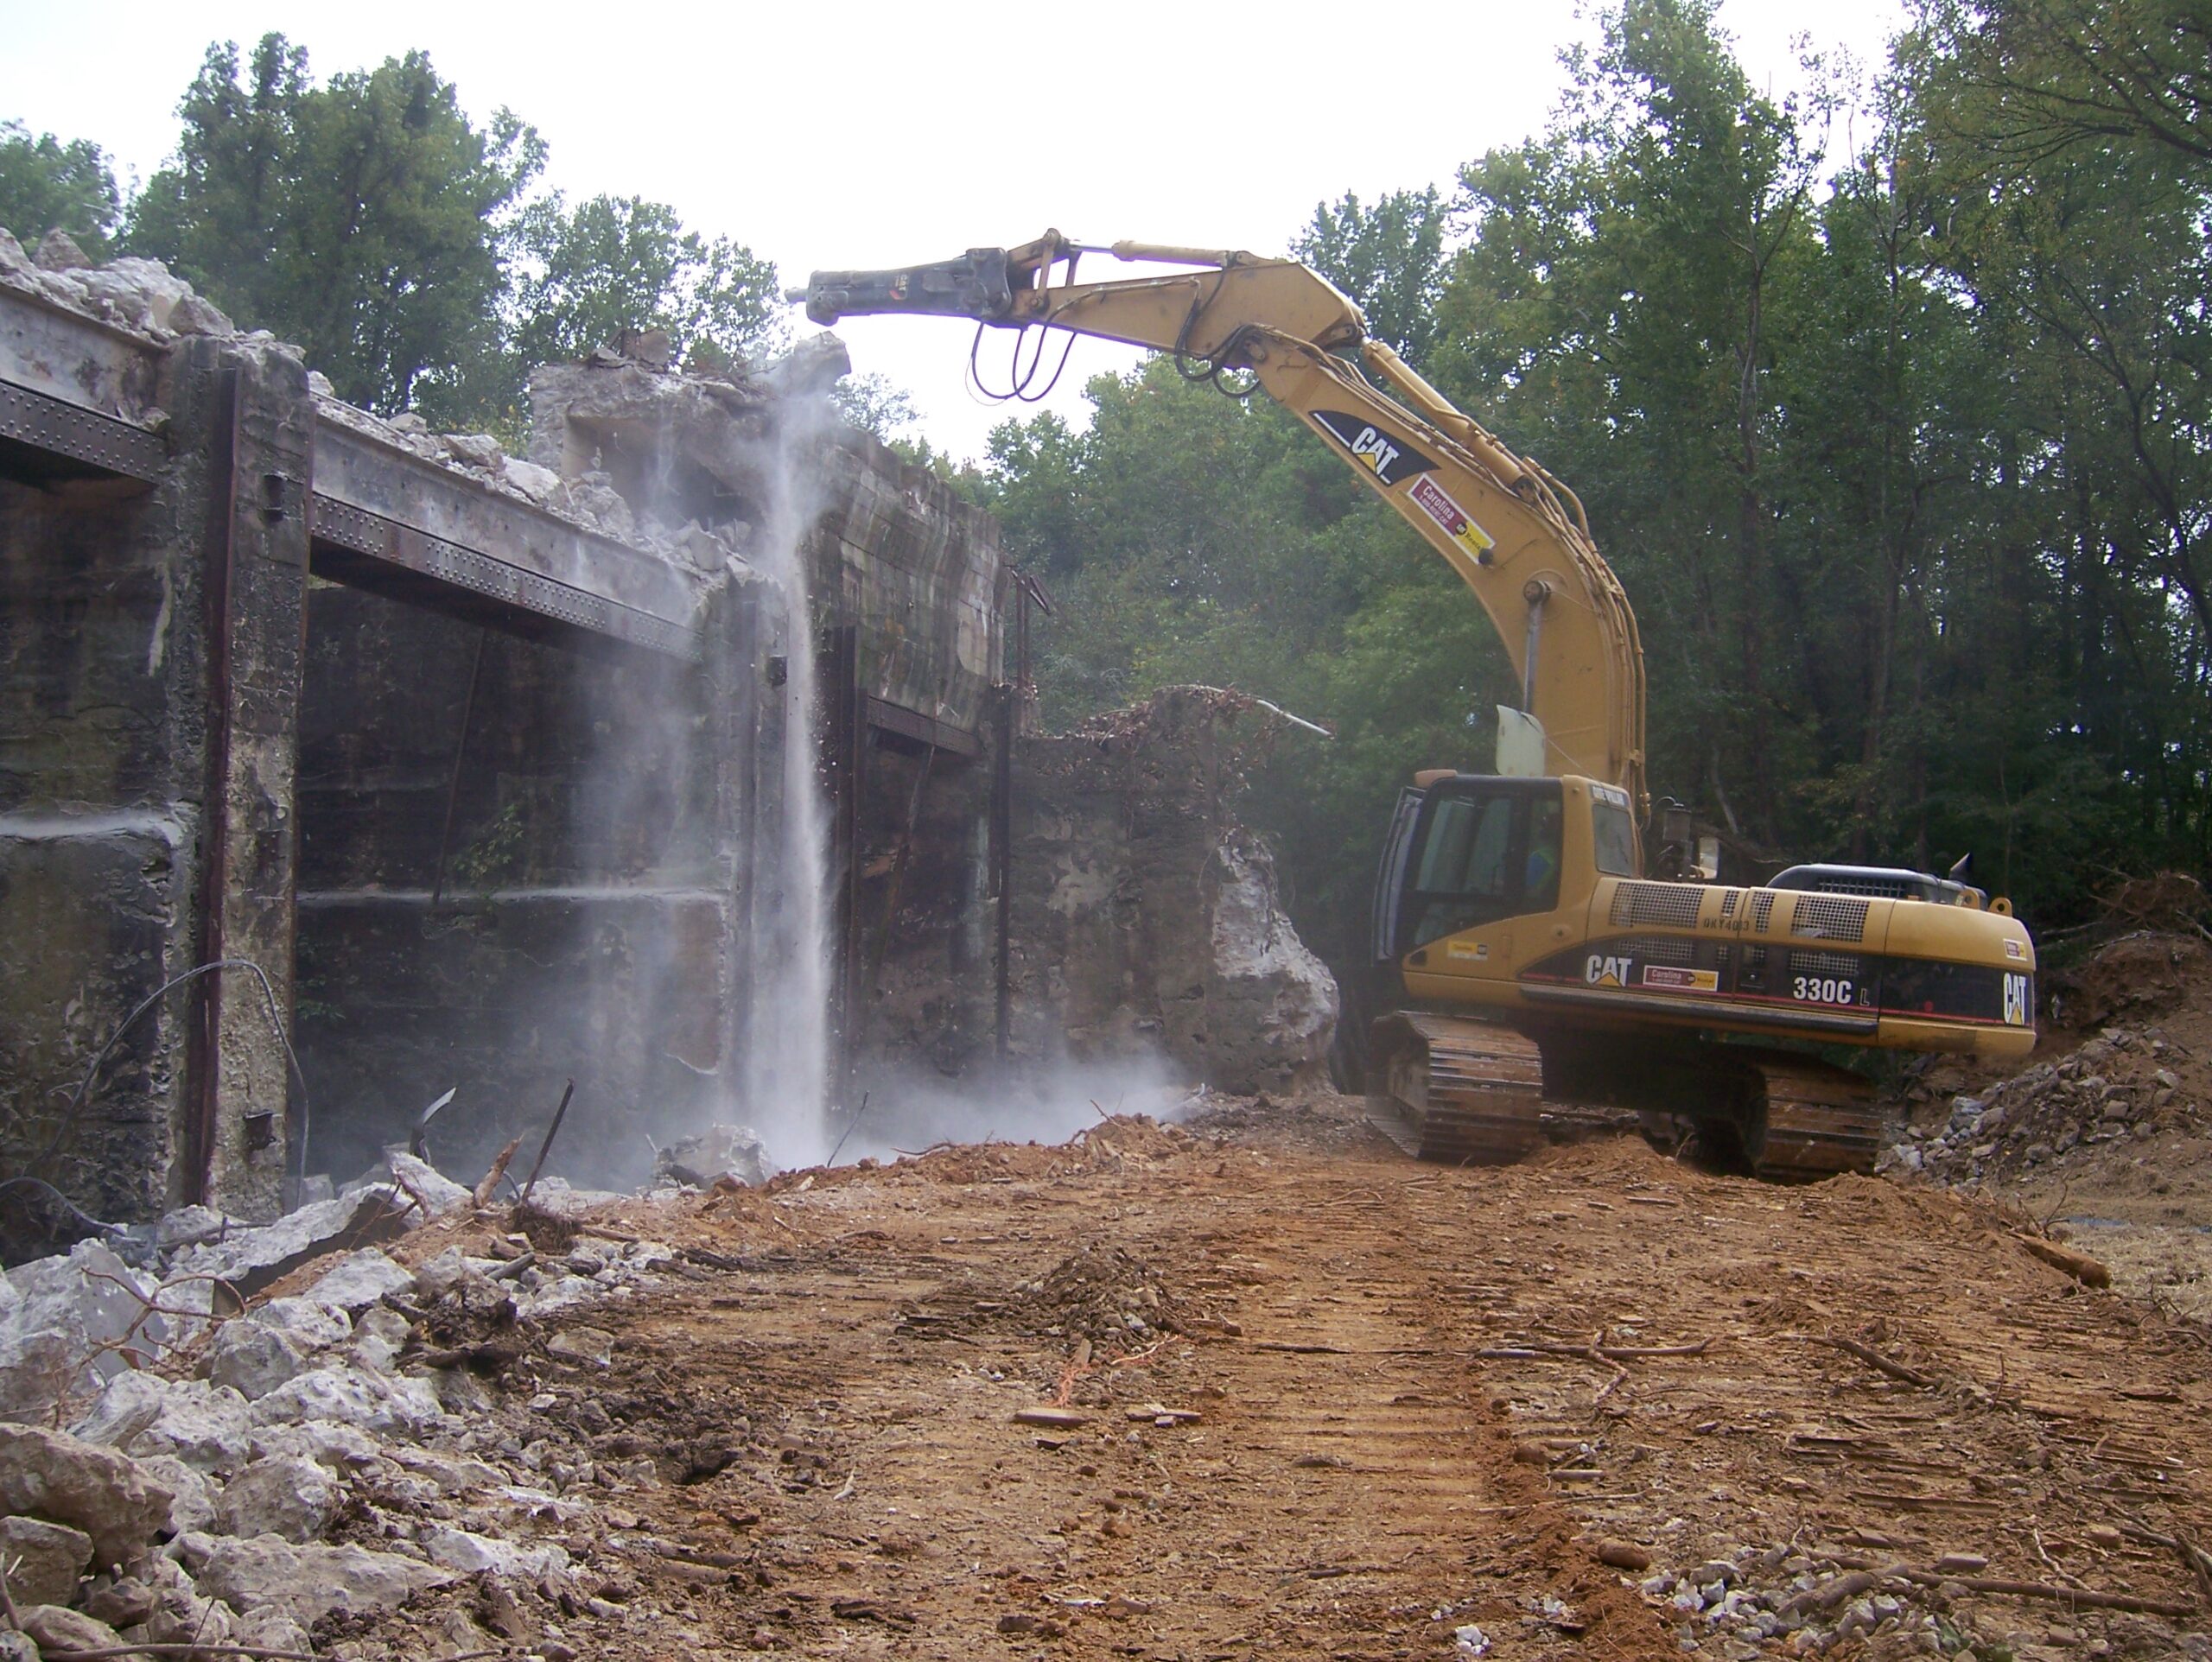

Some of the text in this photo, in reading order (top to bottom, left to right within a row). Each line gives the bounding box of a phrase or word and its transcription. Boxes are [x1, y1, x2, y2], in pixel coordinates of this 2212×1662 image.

[1351, 427, 1399, 475] CAT
[1422, 485, 1455, 520] Carolina
[1586, 955, 1632, 987] CAT
[1651, 968, 1682, 980] Carolina
[1793, 976, 1871, 1006] 330C L
[2004, 972, 2026, 1025] CAT
